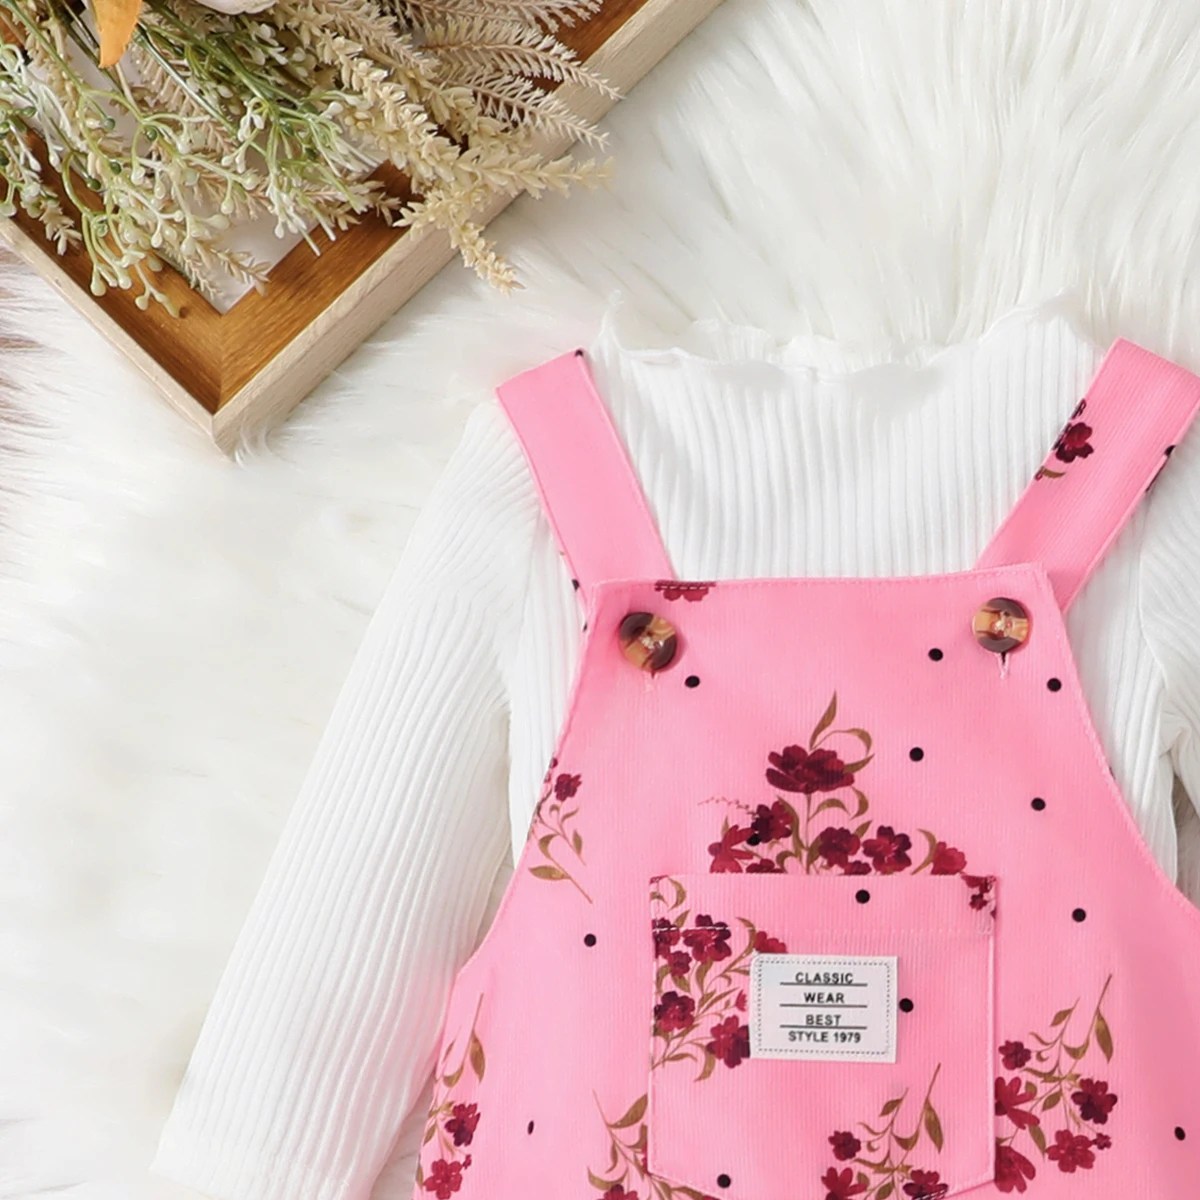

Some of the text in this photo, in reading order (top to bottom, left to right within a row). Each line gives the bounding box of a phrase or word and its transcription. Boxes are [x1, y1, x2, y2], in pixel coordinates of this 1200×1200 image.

[795, 972, 854, 984] CLASSIC
[803, 992, 845, 1003] WEAR
[805, 1014, 842, 1026] BEST
[788, 1031, 861, 1044] STYLE 1979
